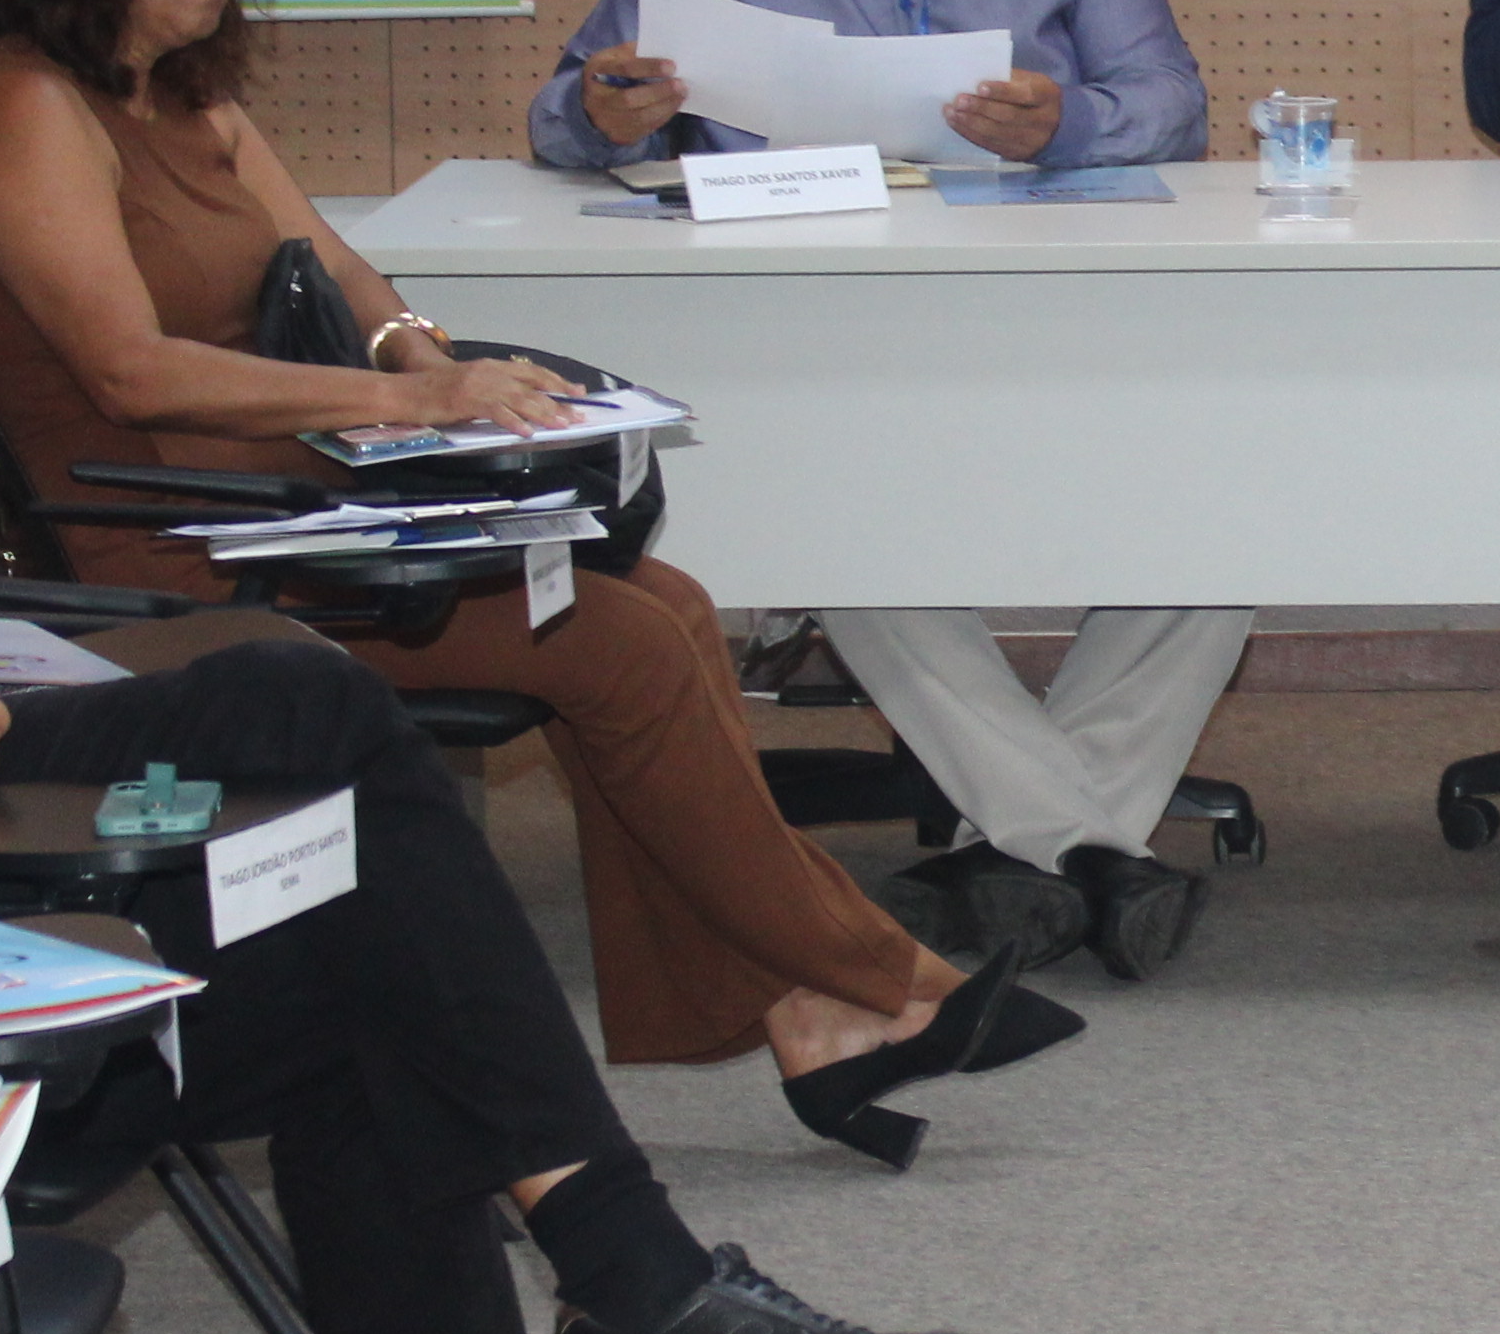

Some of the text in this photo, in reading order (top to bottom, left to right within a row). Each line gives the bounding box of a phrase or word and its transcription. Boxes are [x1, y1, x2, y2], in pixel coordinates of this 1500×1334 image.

[701, 168, 861, 188] THIAGO DOS SANTOS XAVIER
[221, 867, 250, 889] TIAGO
